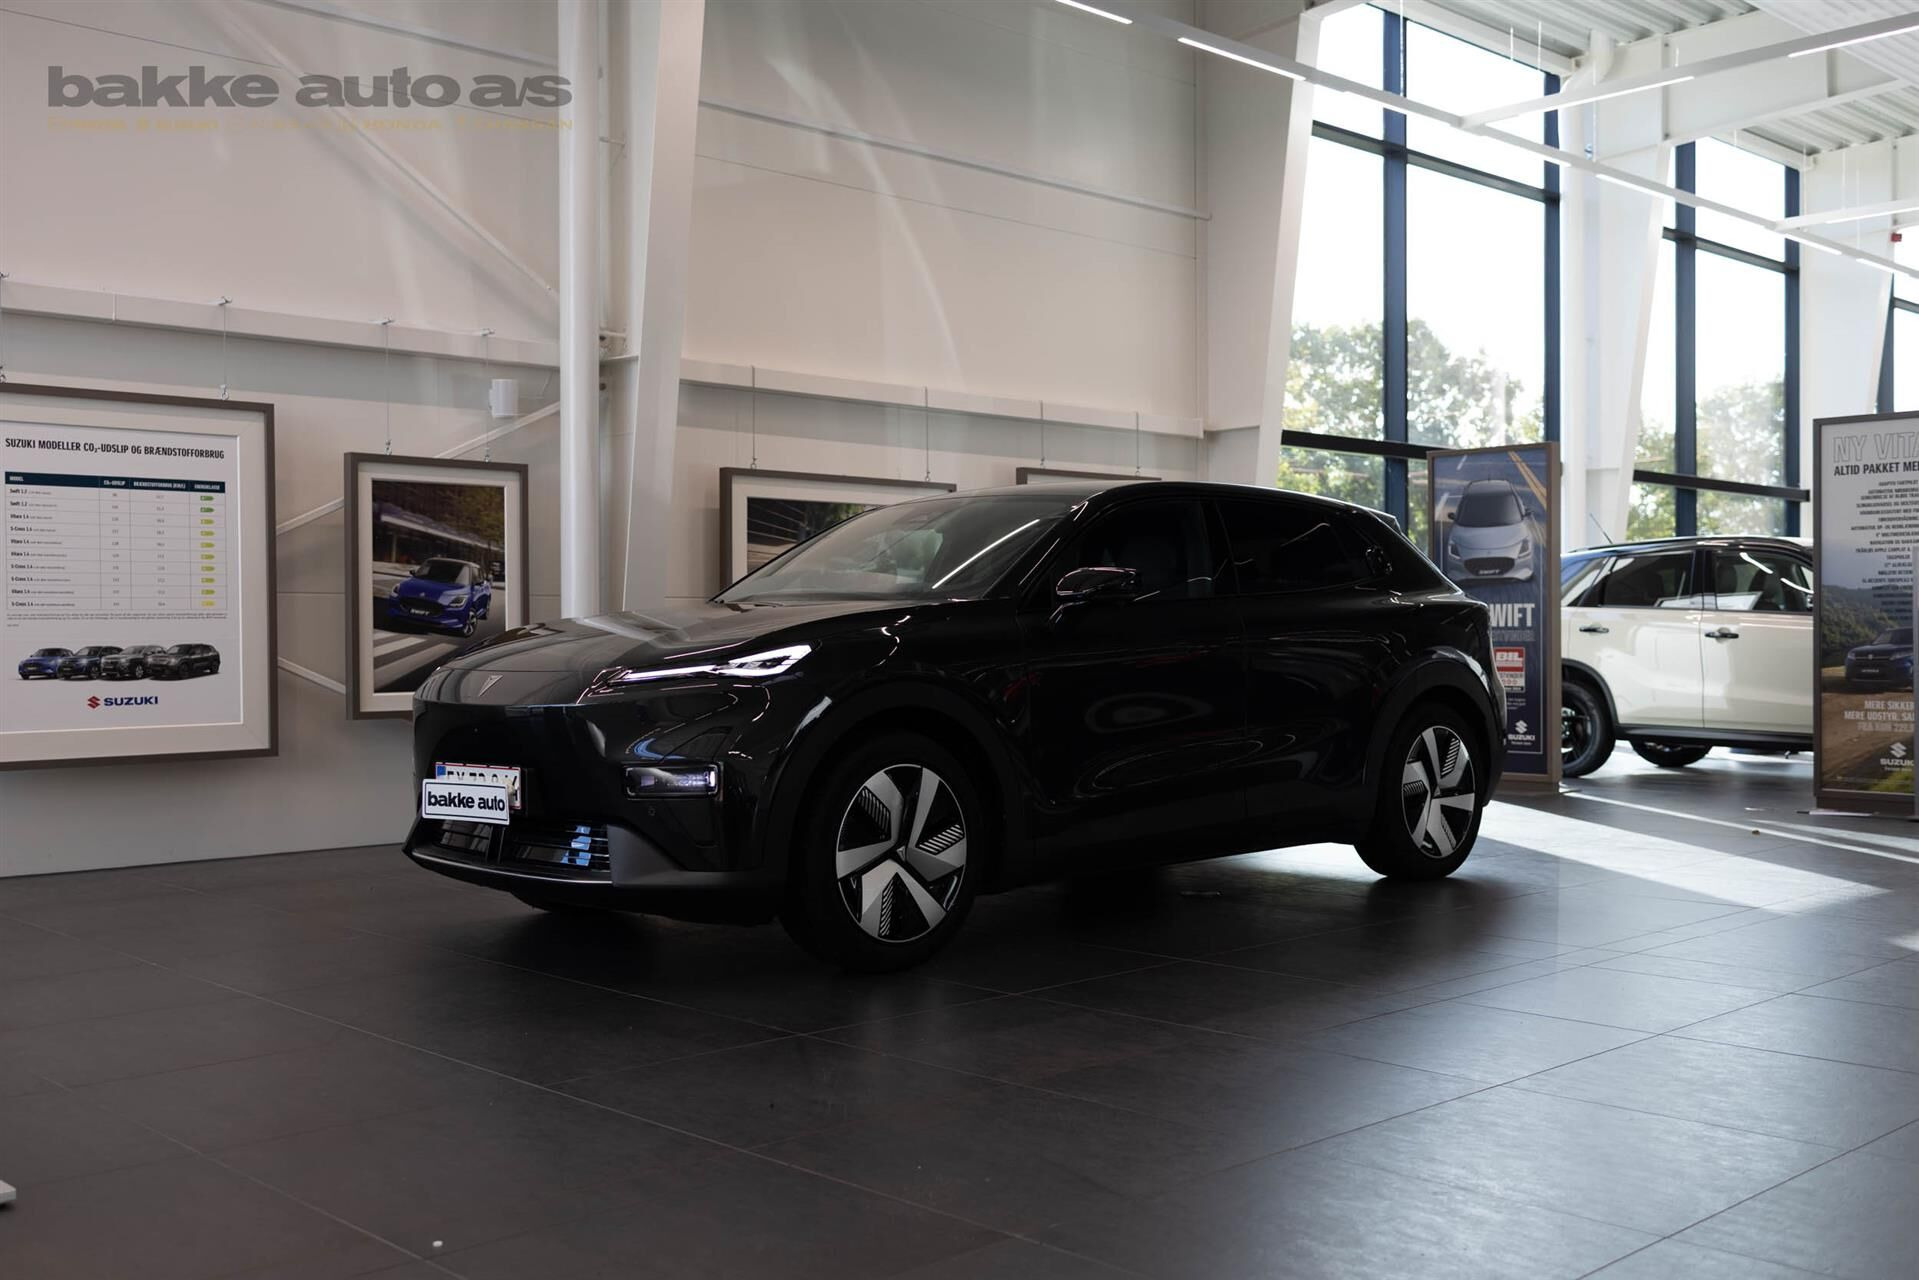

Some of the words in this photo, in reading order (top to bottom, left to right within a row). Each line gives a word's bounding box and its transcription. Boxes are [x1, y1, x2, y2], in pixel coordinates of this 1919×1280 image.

[5, 438, 36, 449] SUZUKI
[38, 440, 81, 451] MODELLER
[131, 445, 142, 454] OG
[144, 446, 224, 459] BRÆNDSTOFFORBRUG
[1833, 434, 1867, 462] NY
[1834, 464, 1860, 476] ALTID
[1863, 462, 1900, 474] PAKKET
[1490, 603, 1535, 627] WIFT
[103, 696, 158, 706] SUZUKI
[1880, 758, 1914, 766] SUZUK
[428, 791, 475, 808] bakke
[478, 796, 505, 811] auto
